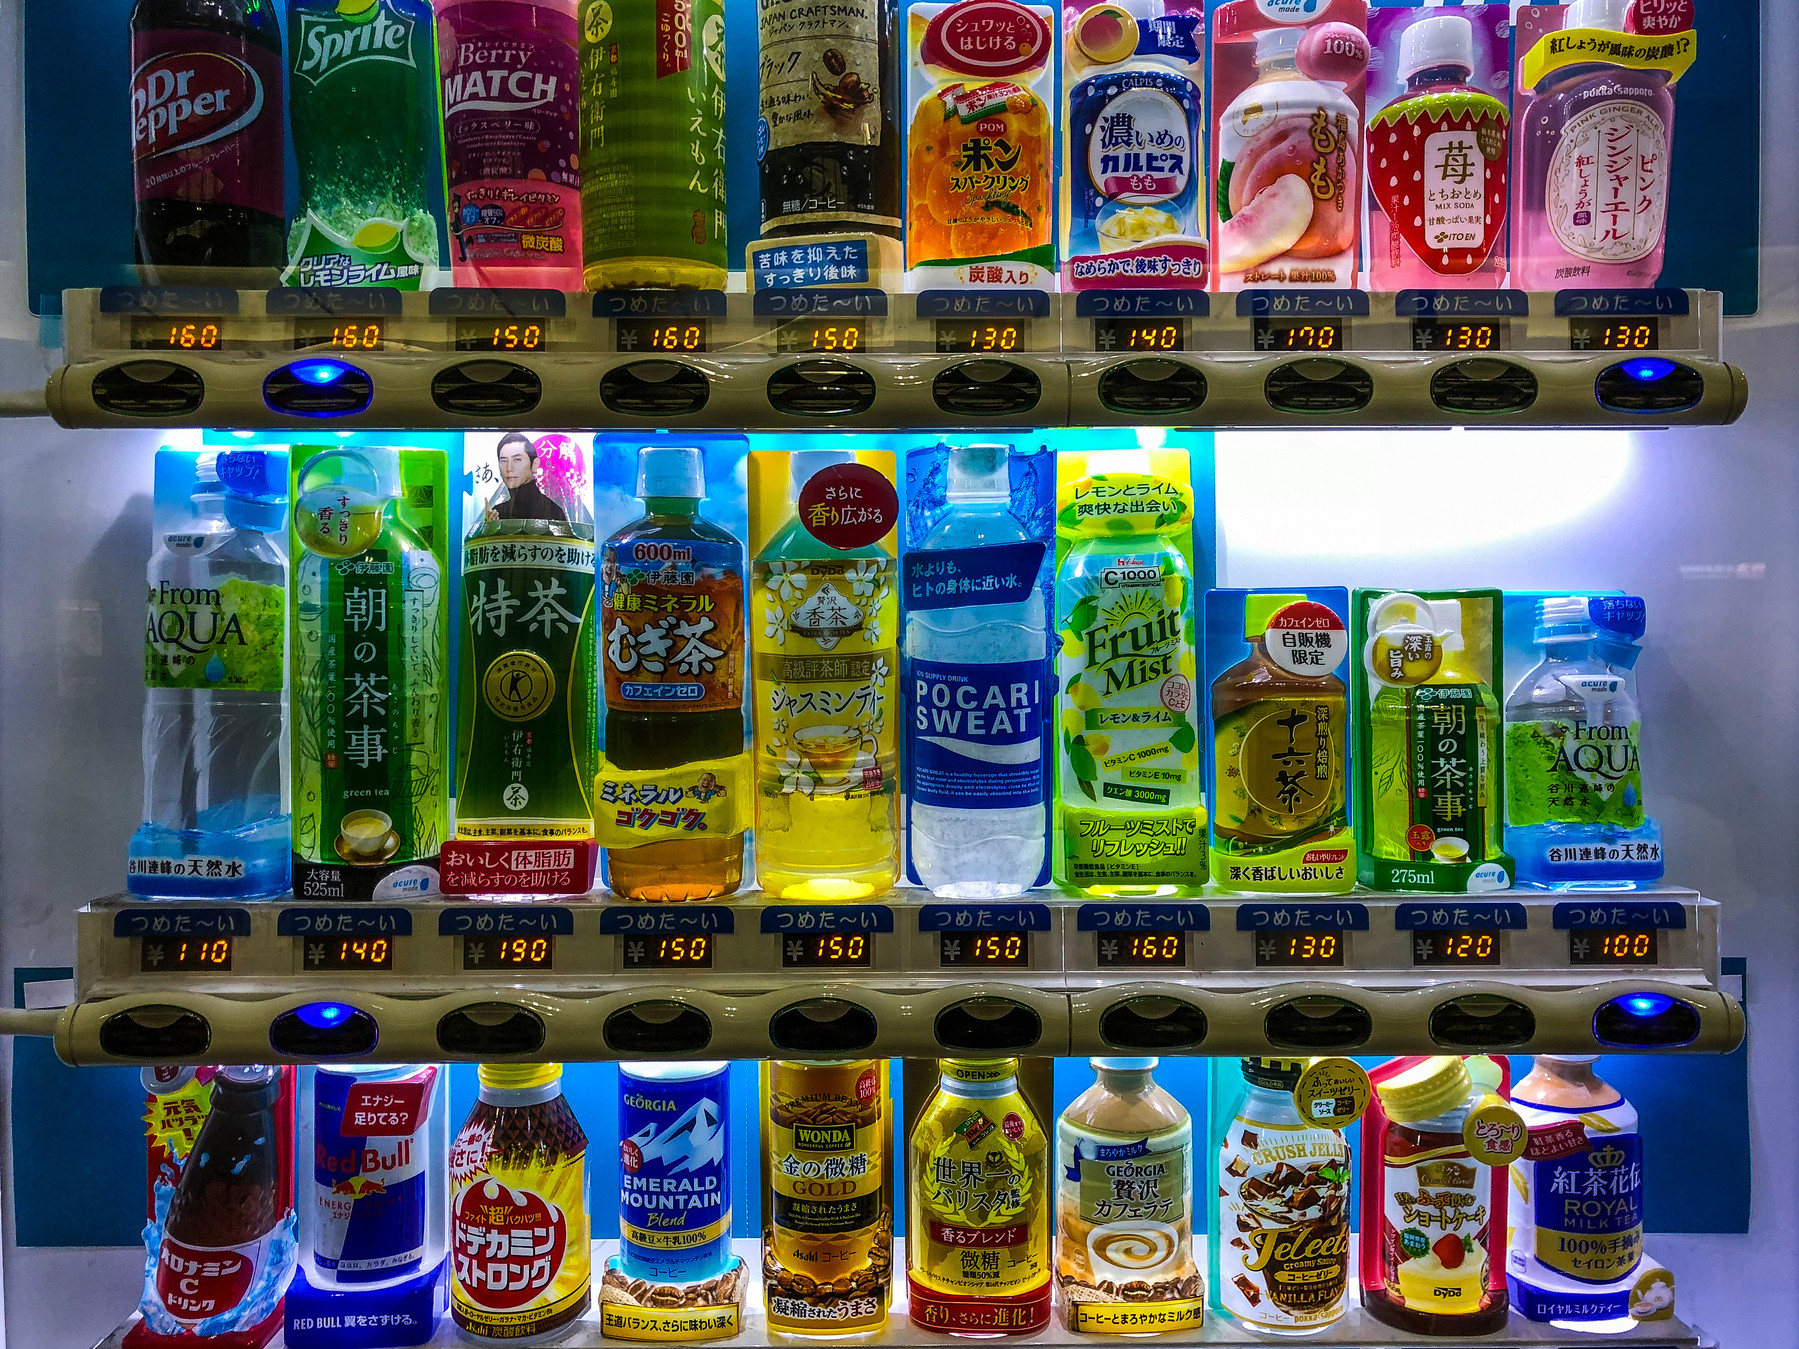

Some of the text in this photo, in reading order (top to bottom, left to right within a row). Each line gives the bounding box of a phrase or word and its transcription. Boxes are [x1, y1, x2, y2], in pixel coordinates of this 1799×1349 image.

[956, 20, 1015, 34] シュワッと
[1642, 15, 1681, 29] 爽やか
[302, 18, 406, 71] Sprite
[960, 36, 1017, 51] はじける
[458, 42, 532, 68] Berry
[145, 68, 194, 111] Dr
[1122, 79, 1153, 88] CALPIS
[1600, 106, 1643, 115] GINGER
[980, 122, 1005, 131] POM
[1101, 114, 1185, 149] 濃いめの
[960, 139, 1021, 172] ポン
[1311, 109, 1335, 200] もも
[1435, 141, 1475, 184] 苺
[1101, 153, 1185, 176] カルピス
[950, 176, 1030, 193] スパークリング
[1130, 176, 1156, 190] もも
[1600, 126, 1633, 242] ジンジャーエール
[1637, 154, 1658, 215] ピンク
[1428, 189, 1482, 201] とちおとめ
[1454, 202, 1475, 210] SODA
[1427, 215, 1482, 226] 甘酸っぱい果実
[759, 246, 858, 268] 苦味を抑えた
[764, 264, 858, 287] すっきり後味
[968, 267, 1029, 284] 炭酸入り
[1244, 272, 1286, 282] ストレート
[1555, 266, 1590, 278] 炭酸飲料
[169, 325, 218, 347] 160
[332, 325, 379, 348] 160
[492, 325, 540, 348] 150
[652, 327, 700, 349] 160
[812, 328, 859, 349] 150
[970, 328, 1016, 349] 130
[1129, 327, 1177, 348] 140
[1288, 327, 1334, 348] 170
[1445, 327, 1492, 348] 130
[1604, 326, 1650, 347] 130
[826, 486, 863, 500] さらに
[1075, 484, 1178, 499] レモンとライム
[808, 503, 883, 527] 香り広がる
[1078, 502, 1176, 516] 爽快な出会い
[318, 507, 334, 534] 香る
[337, 496, 350, 545] すっきり
[634, 544, 691, 561] 600ml
[355, 562, 394, 574] 伊藤園
[811, 568, 844, 577] DyDo
[646, 571, 694, 585] 伊藤園
[912, 572, 1022, 598] ヒトの身体に近い水。
[159, 580, 221, 606] From
[817, 596, 837, 605] 贅沢
[470, 577, 582, 639] 特茶
[613, 594, 714, 612] 健康ミネラル
[803, 607, 849, 626] 香茶
[1279, 617, 1329, 628] カフェインゼロ
[607, 616, 724, 675] むぎ茶
[1086, 608, 1181, 670] Fruit
[1283, 633, 1332, 648] 自販機
[1291, 650, 1325, 665] 限定
[343, 586, 389, 769] 朝の茶事
[925, 671, 968, 682] SUPPLY DRINK
[1103, 654, 1172, 696] Mist
[625, 685, 699, 697] カフェインゼロ
[917, 680, 1039, 709] POCARI
[917, 708, 1031, 734] SWEAT
[1100, 713, 1171, 724] レモン&ライム
[1574, 721, 1629, 741] From
[1317, 707, 1328, 779] 深煎り焙煎
[511, 730, 523, 782] 伊右衛門
[1104, 746, 1169, 768] ビタミンC 1000mg
[1272, 708, 1313, 814] 十六茶
[1431, 704, 1466, 821] 朝の茶事
[1129, 770, 1182, 781] ビタミンE 10mg
[343, 789, 372, 798] green
[600, 782, 684, 805] ミネラル
[1134, 790, 1166, 802] 3000mg
[1548, 783, 1615, 794] 谷川連峰の
[1548, 797, 1590, 807] 天然水
[1080, 819, 1196, 837] フルーツミストで
[1549, 845, 1660, 862] 谷川連峰の天然水
[129, 859, 242, 878] 谷川連峰の天然水
[307, 869, 341, 882] 大容量
[1230, 866, 1344, 881] 深く香ばしいおいしさ
[1391, 869, 1434, 885] 275ml
[393, 878, 418, 888] acure
[446, 871, 571, 888] を減らすのを助ける
[304, 883, 344, 897] 525ml
[180, 941, 227, 962] 110
[340, 941, 386, 962] 140
[500, 940, 546, 961] 190
[660, 938, 706, 960] 150
[819, 937, 864, 958] 150
[976, 937, 1020, 958] 150
[1132, 936, 1178, 958] 160
[1290, 936, 1336, 958] 130
[1447, 936, 1492, 957] 120
[1603, 934, 1649, 956] 100
[1309, 1084, 1360, 1098] スイーツゼリー
[163, 1099, 202, 1114] 元気
[362, 1096, 404, 1107] エナジー
[1313, 1101, 1333, 1110] クリーミー
[354, 1112, 409, 1126] 足りてる?
[798, 1128, 850, 1142] WONDA
[1100, 1146, 1143, 1157] まろやかミルク
[1485, 1138, 1513, 1154] 食感
[316, 1139, 411, 1173] Red Bull
[783, 1154, 867, 1178] 金の微糖
[933, 1157, 1021, 1188] 世界一の
[624, 1176, 717, 1190] EMERALD
[792, 1181, 857, 1197] GOLD
[1114, 1179, 1160, 1201] 贅沢
[622, 1192, 720, 1209] MOUNTAIN
[1094, 1199, 1174, 1220] カフェラテ
[1565, 1200, 1638, 1218] ROYAL
[464, 1211, 487, 1224] ファイト
[647, 1211, 688, 1228] Blend
[1564, 1214, 1638, 1228] MILK TEA
[455, 1220, 554, 1259] ドデカミン
[941, 1228, 1016, 1245] 香るブレンド
[793, 1251, 857, 1263] Asahi コーヒー
[960, 1251, 999, 1270] 微糖
[1284, 1260, 1316, 1270] creamy
[457, 1256, 551, 1291] ストロング
[649, 1267, 686, 1278] コーヒー
[1288, 1270, 1334, 1281] コーヒーゼリー
[179, 1279, 198, 1294] C
[1434, 1287, 1462, 1298] DyDo
[167, 1295, 215, 1312] ドリンク
[773, 1298, 878, 1319] 凝縮されたうまさ
[1537, 1303, 1621, 1314] ロイヤルミルクティー
[293, 1314, 418, 1330] RED BULL 翼をさずける。
[605, 1312, 734, 1333] 王道バランス、さらに味わい深く
[1080, 1310, 1200, 1325] コーヒーとまろやかなミルク感
